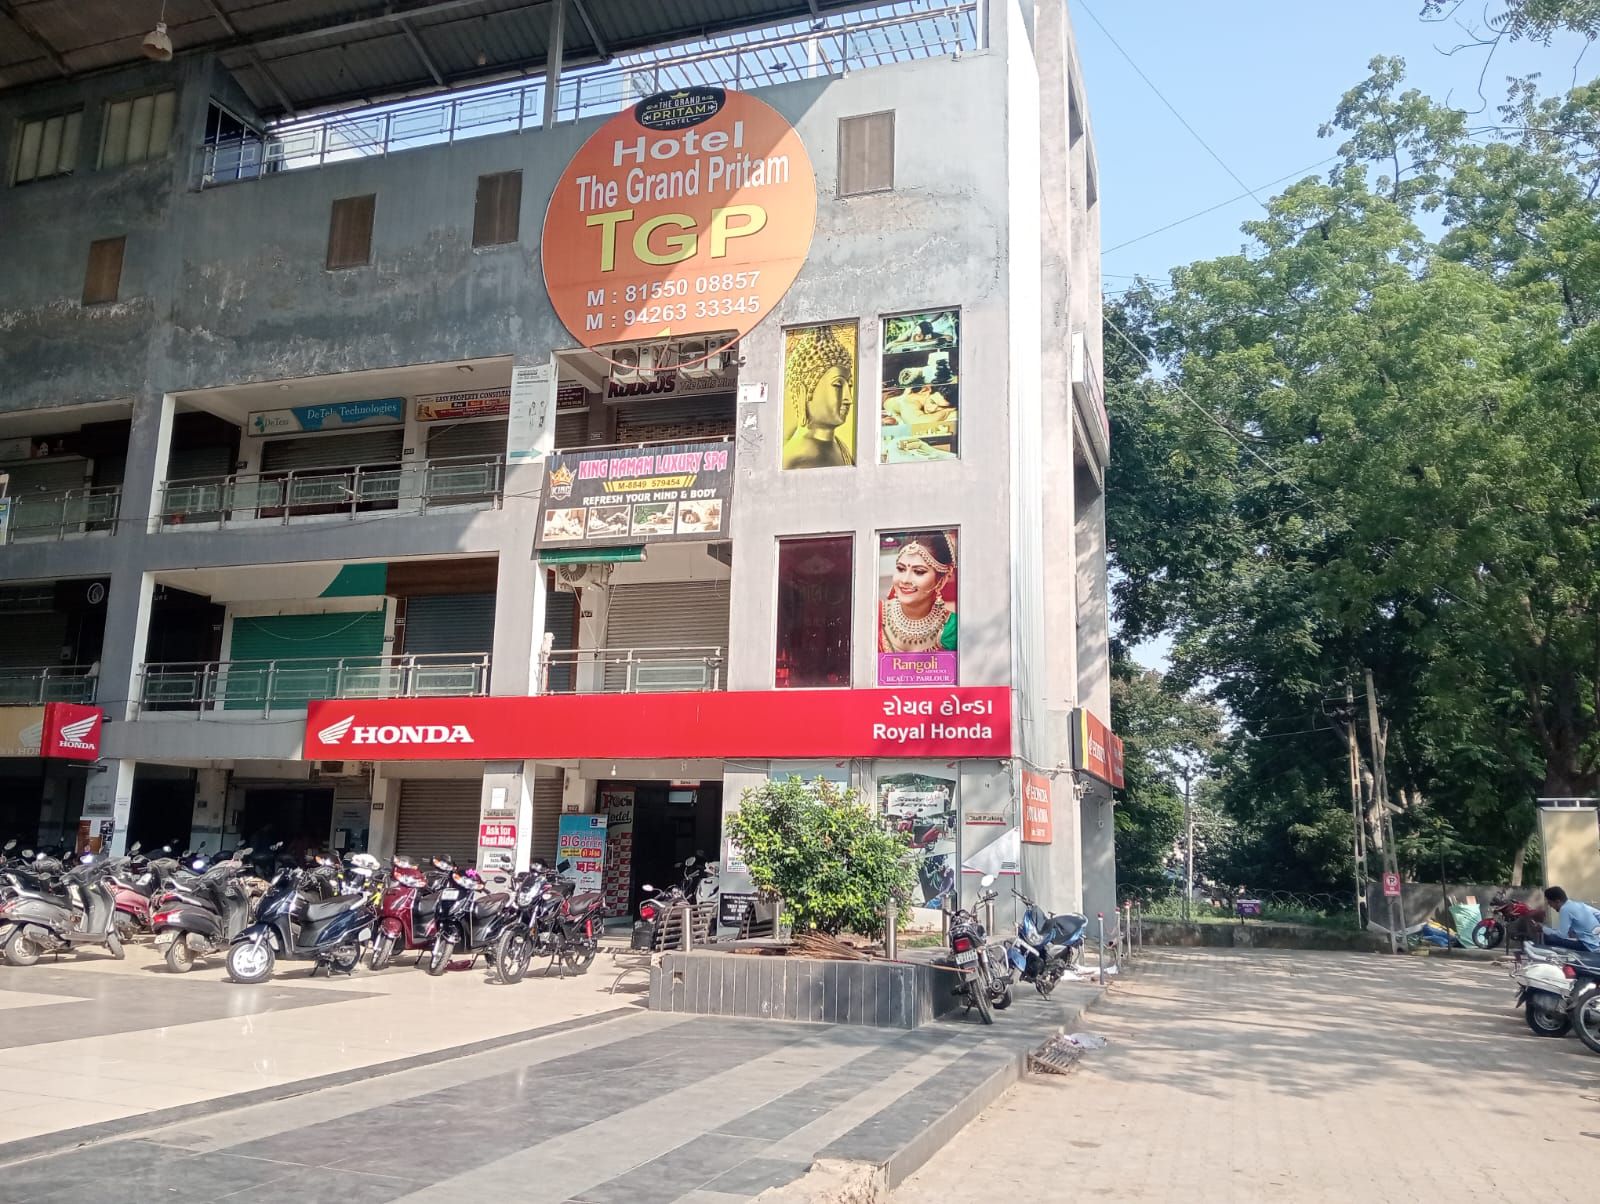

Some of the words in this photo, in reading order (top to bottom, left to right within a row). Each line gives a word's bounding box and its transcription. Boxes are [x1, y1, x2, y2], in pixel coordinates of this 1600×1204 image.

[660, 100, 672, 109] THE
[674, 95, 700, 107] GRAND
[653, 104, 706, 120] PRITAM
[665, 117, 690, 126] HOTEL
[612, 120, 743, 167] Hotel
[576, 176, 617, 212] The
[626, 158, 700, 205] Grand
[708, 152, 790, 193] Pritam
[585, 203, 768, 273] TGP
[625, 278, 688, 303] 81550
[695, 270, 761, 293] 08857
[623, 303, 687, 327] 94263
[695, 295, 760, 318] 33345
[340, 402, 397, 417] Technologies
[578, 459, 609, 480] KING
[655, 452, 704, 474] LUXURY
[703, 450, 728, 472] SPA
[583, 494, 623, 506] REFRESH
[626, 492, 651, 503] YOUR
[653, 490, 678, 501] MIND
[690, 487, 717, 498] BODY
[893, 655, 938, 674] Rangoli
[916, 674, 950, 682] PARLOUR
[883, 695, 933, 716] રોયલ
[940, 694, 993, 716] હોન્ડા
[352, 724, 475, 744] HONDA
[873, 723, 925, 743] Royal
[931, 723, 992, 739] Honda
[59, 740, 96, 750] HONDA
[486, 825, 500, 836] Ask
[500, 825, 511, 836] for
[481, 835, 498, 846] Test
[498, 835, 515, 846] Ride
[560, 835, 580, 847] BIG
